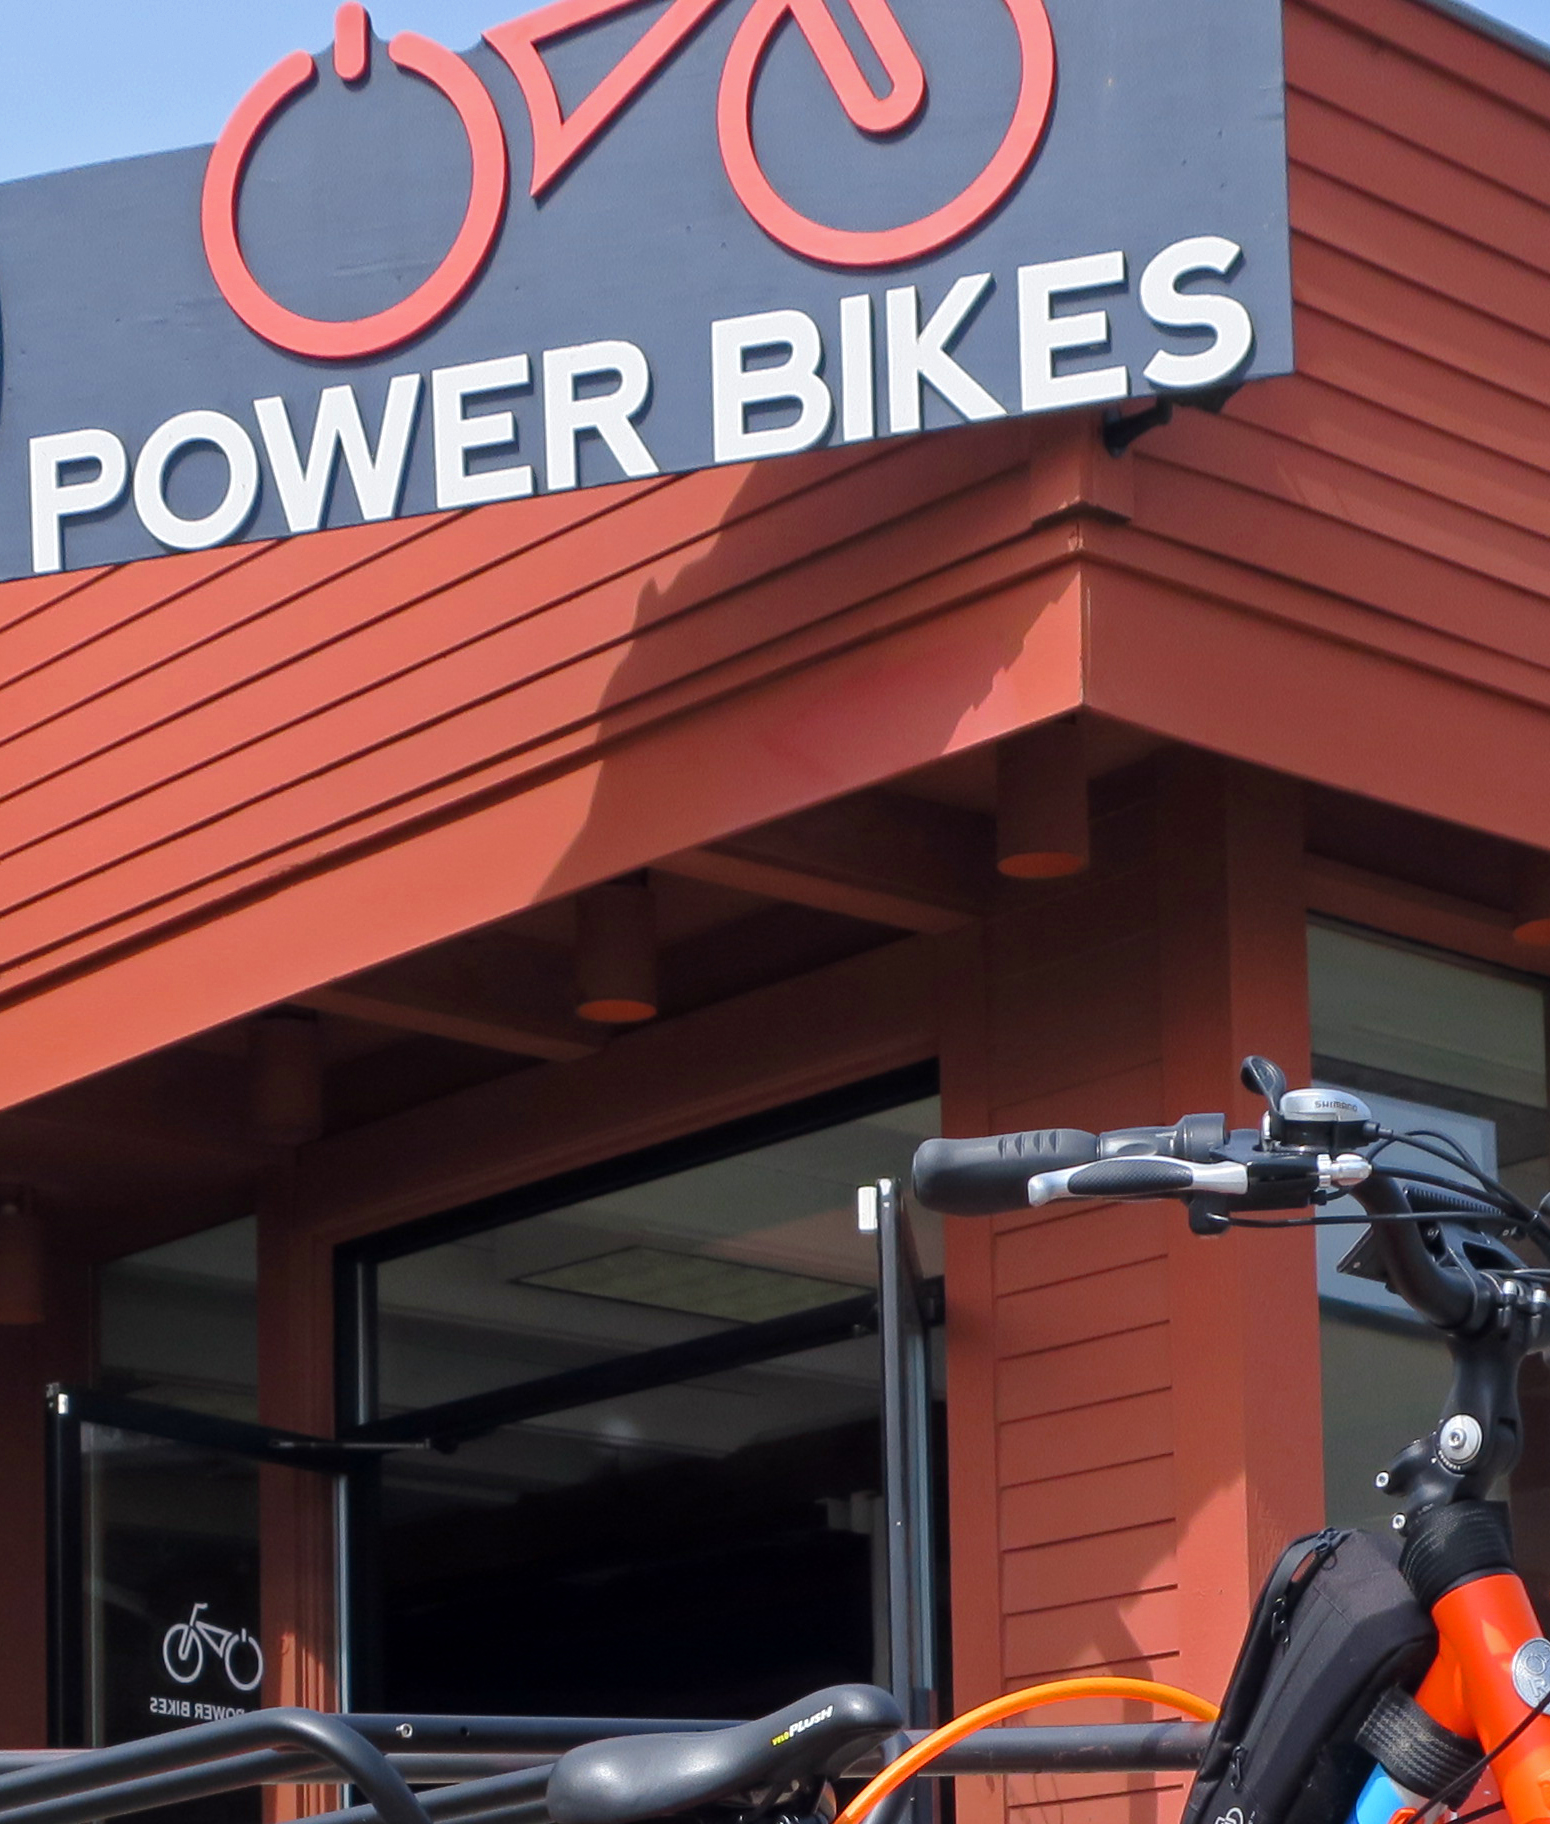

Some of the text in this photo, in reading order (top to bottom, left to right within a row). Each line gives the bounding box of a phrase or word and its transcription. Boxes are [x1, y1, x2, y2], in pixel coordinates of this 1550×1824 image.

[28, 235, 1252, 573] POWER BIKES
[789, 1704, 834, 1738] PLUSH
